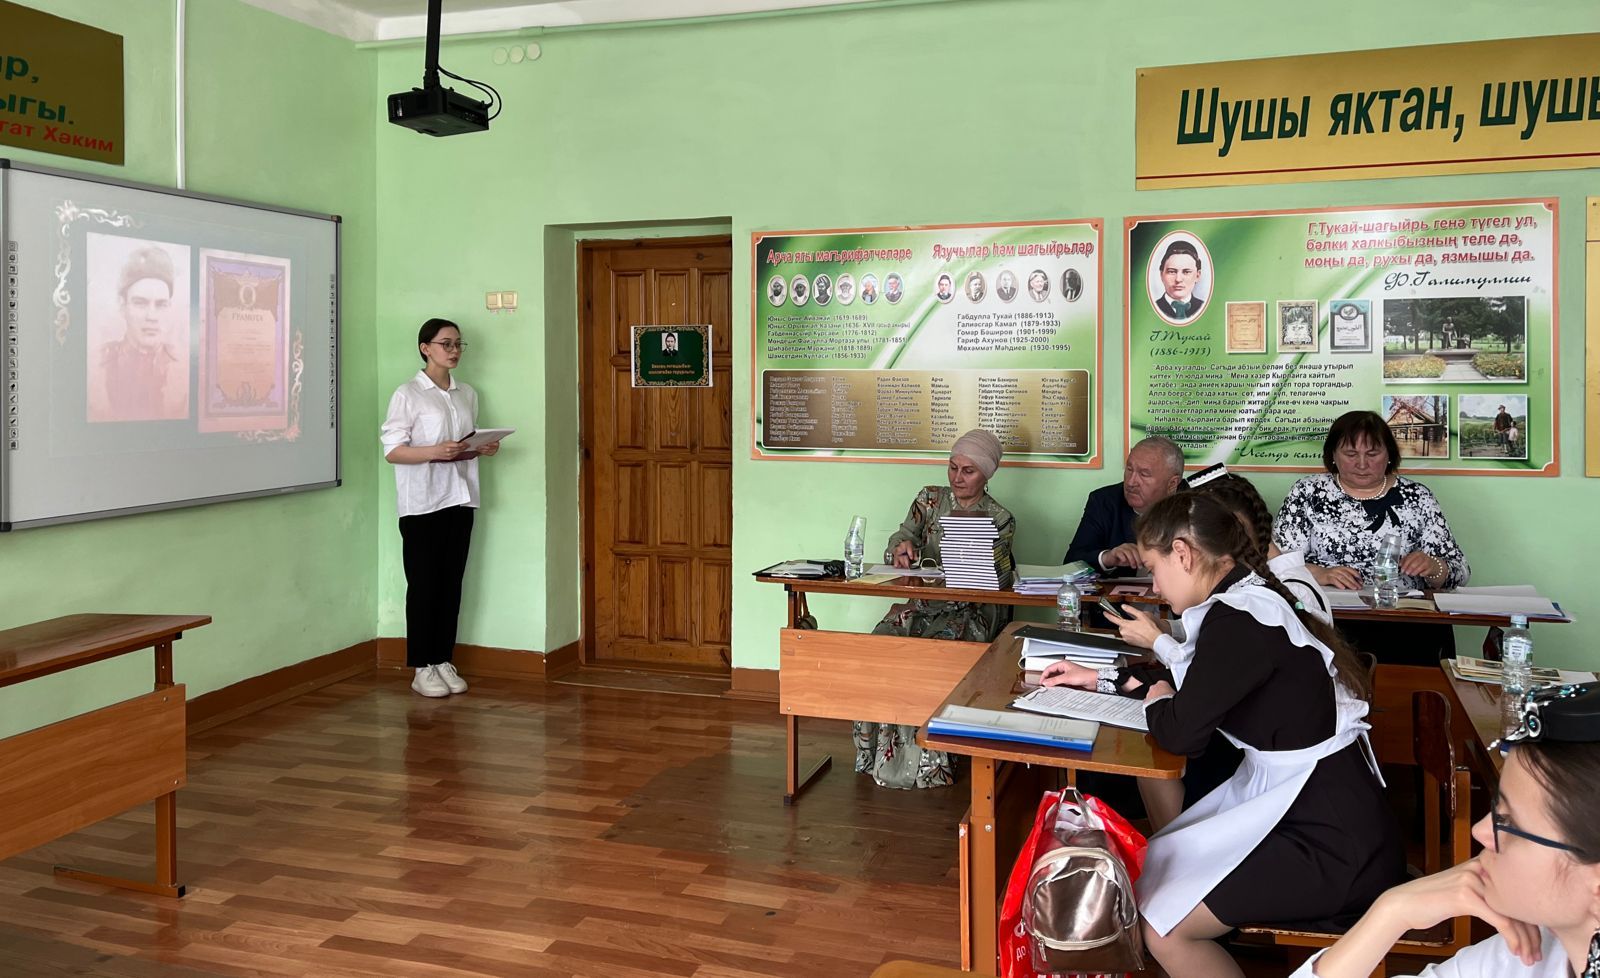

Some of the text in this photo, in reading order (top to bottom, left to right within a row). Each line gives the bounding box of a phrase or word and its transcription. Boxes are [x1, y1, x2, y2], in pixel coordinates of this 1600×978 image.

[0, 55, 39, 83] р,
[1176, 87, 1311, 158] Шушы
[1328, 86, 1465, 143] яктан,
[44, 125, 114, 152] Хәким
[1308, 216, 1538, 238] Г.Тукай-шагыйрь генә түгел ул,
[1306, 233, 1523, 252] бәлки халкыбызның теле дә,
[767, 249, 792, 265] Арча
[795, 251, 813, 264] ягы
[932, 241, 1094, 262] Язучылар һәм шагыйрьләр
[1304, 250, 1536, 269] моңы да, рухы да, язмышы да.
[957, 313, 991, 321] Габдулла
[1020, 320, 1061, 328] (1879-1933)
[1016, 328, 1057, 336] (1901-1999)
[1149, 330, 1211, 345] Г.Тукай
[1150, 347, 1211, 357] (1886-1913)
[1324, 363, 1354, 371] утырып
[1308, 371, 1336, 379] кайтып
[1264, 407, 1282, 415] бара
